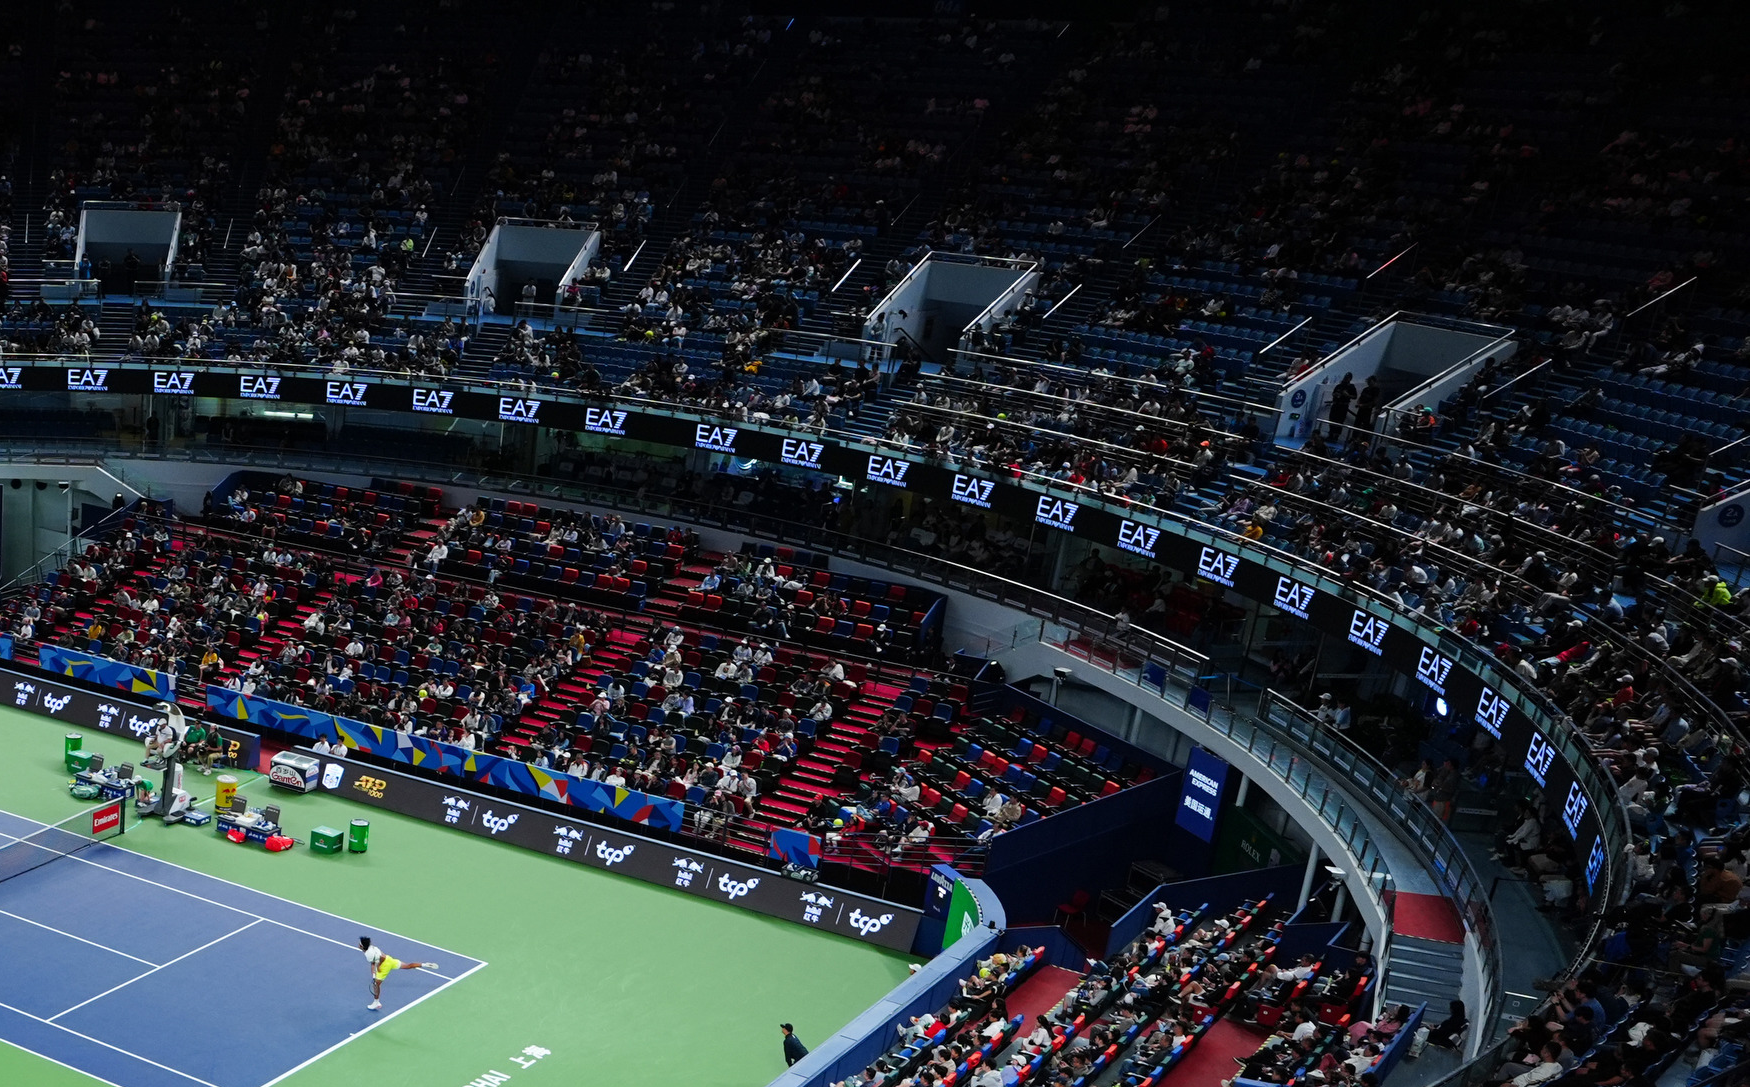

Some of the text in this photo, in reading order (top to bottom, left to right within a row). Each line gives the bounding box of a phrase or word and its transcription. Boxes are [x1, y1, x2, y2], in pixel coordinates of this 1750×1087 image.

[68, 369, 108, 385] EA7
[154, 373, 194, 389] EA7
[241, 376, 281, 394] EA7
[327, 382, 367, 400] EA7
[413, 389, 454, 408] EA7
[499, 398, 541, 417] EA7
[586, 408, 627, 429] EA7
[696, 424, 737, 447] EA7
[782, 439, 823, 462] EA7
[868, 455, 909, 480] EA7
[953, 474, 995, 500] EA7
[1037, 496, 1078, 524] EA7
[1119, 521, 1160, 549] EA7
[1199, 547, 1239, 578] EA7
[1275, 577, 1315, 610] EA7
[1350, 610, 1389, 646] EA7
[1418, 647, 1452, 685] EA7
[44, 691, 65, 713] tcp
[1477, 687, 1510, 728] EA7
[129, 715, 150, 736] tcp
[1527, 732, 1555, 776] EA7
[354, 775, 386, 790] ATP
[1189, 769, 1219, 788] AMERICAN
[1191, 778, 1217, 797] EXPRESS
[1184, 795, 1212, 819] 美国运通
[94, 813, 118, 827] Emirates
[482, 810, 510, 834] tcp
[596, 840, 623, 866] tcp
[1240, 840, 1260, 863] ROLEX
[719, 873, 749, 899] tcp
[849, 908, 881, 936] tcp
[509, 1045, 551, 1069] 上海
